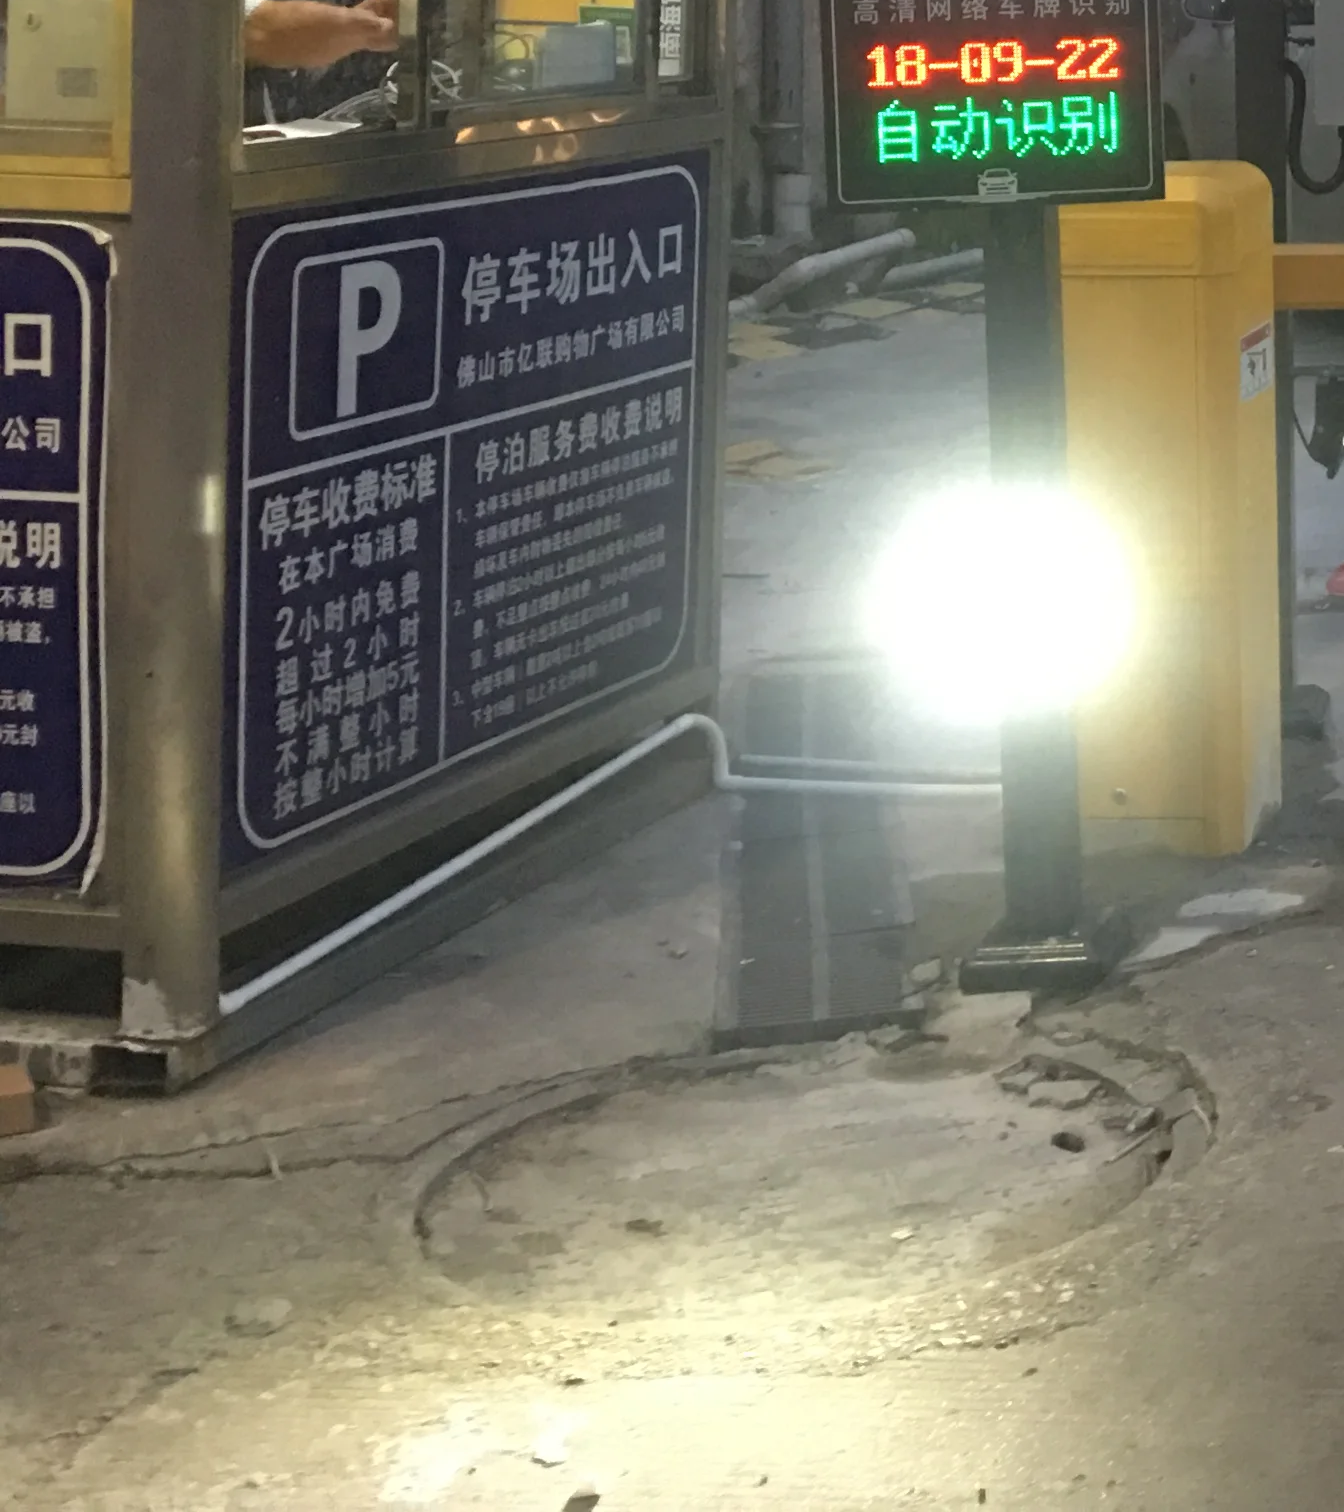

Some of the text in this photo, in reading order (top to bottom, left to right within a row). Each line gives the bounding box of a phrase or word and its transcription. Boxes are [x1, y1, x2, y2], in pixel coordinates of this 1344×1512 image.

[866, 38, 1119, 88] 18-09-22
[876, 90, 1119, 165] 自动识别
[461, 223, 684, 326] 停车场出入口
[4, 313, 52, 377] 口
[336, 259, 402, 419] P
[456, 303, 686, 390] 佛山市亿联购物广场有限公司
[1, 415, 61, 454] 公司
[475, 386, 683, 485] 停泊服务费收费说明
[259, 452, 438, 551] 停车收费标准
[278, 516, 420, 596] 在本广场消费
[275, 569, 422, 652] 2小时内免费
[275, 611, 421, 697] 超过2小时
[275, 651, 421, 735] 每小时增加5元
[274, 687, 420, 776] 不满整小时
[274, 724, 419, 820] 按整小时计算
